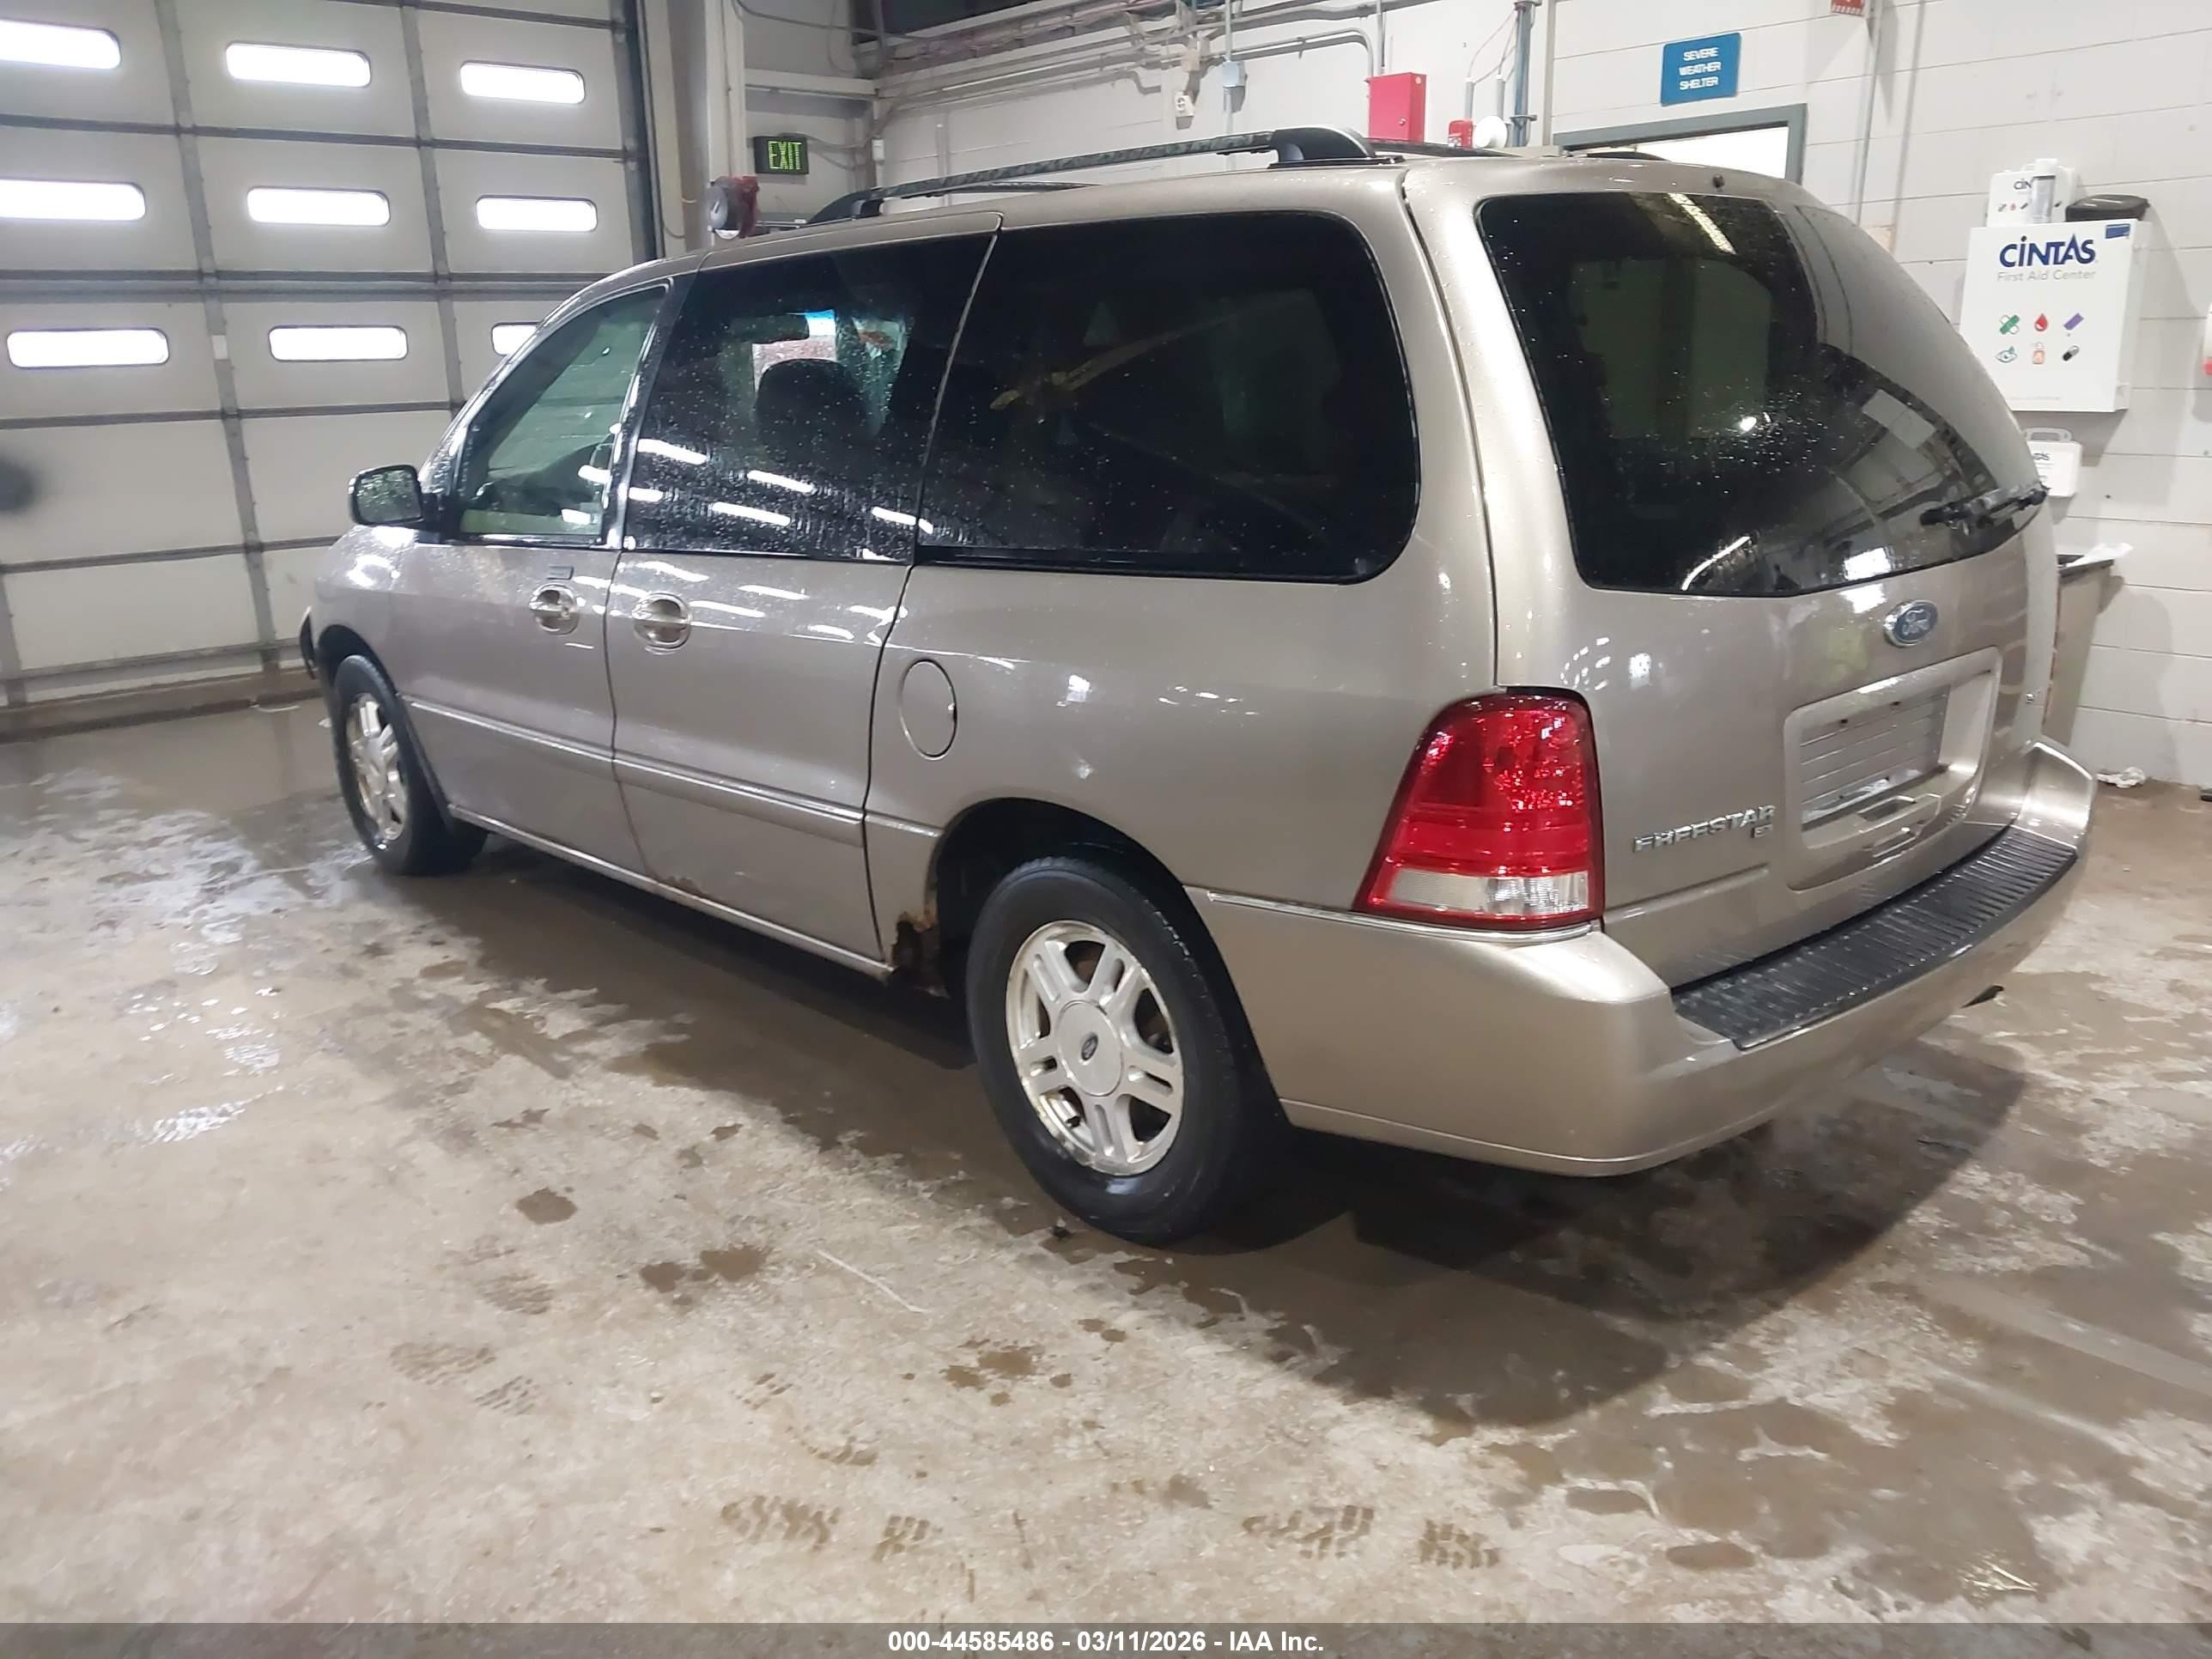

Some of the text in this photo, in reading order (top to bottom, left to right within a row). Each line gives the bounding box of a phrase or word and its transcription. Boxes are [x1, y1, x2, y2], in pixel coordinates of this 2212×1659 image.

[1683, 46, 1719, 61] SEVERE
[1679, 61, 1722, 76] WEATHER
[1679, 76, 1719, 90] SHELTER
[768, 141, 803, 170] EXIT
[1999, 234, 2096, 268] CINTAS
[1996, 270, 2096, 282] First Aid Center
[1633, 805, 1776, 853] FREESTAR
